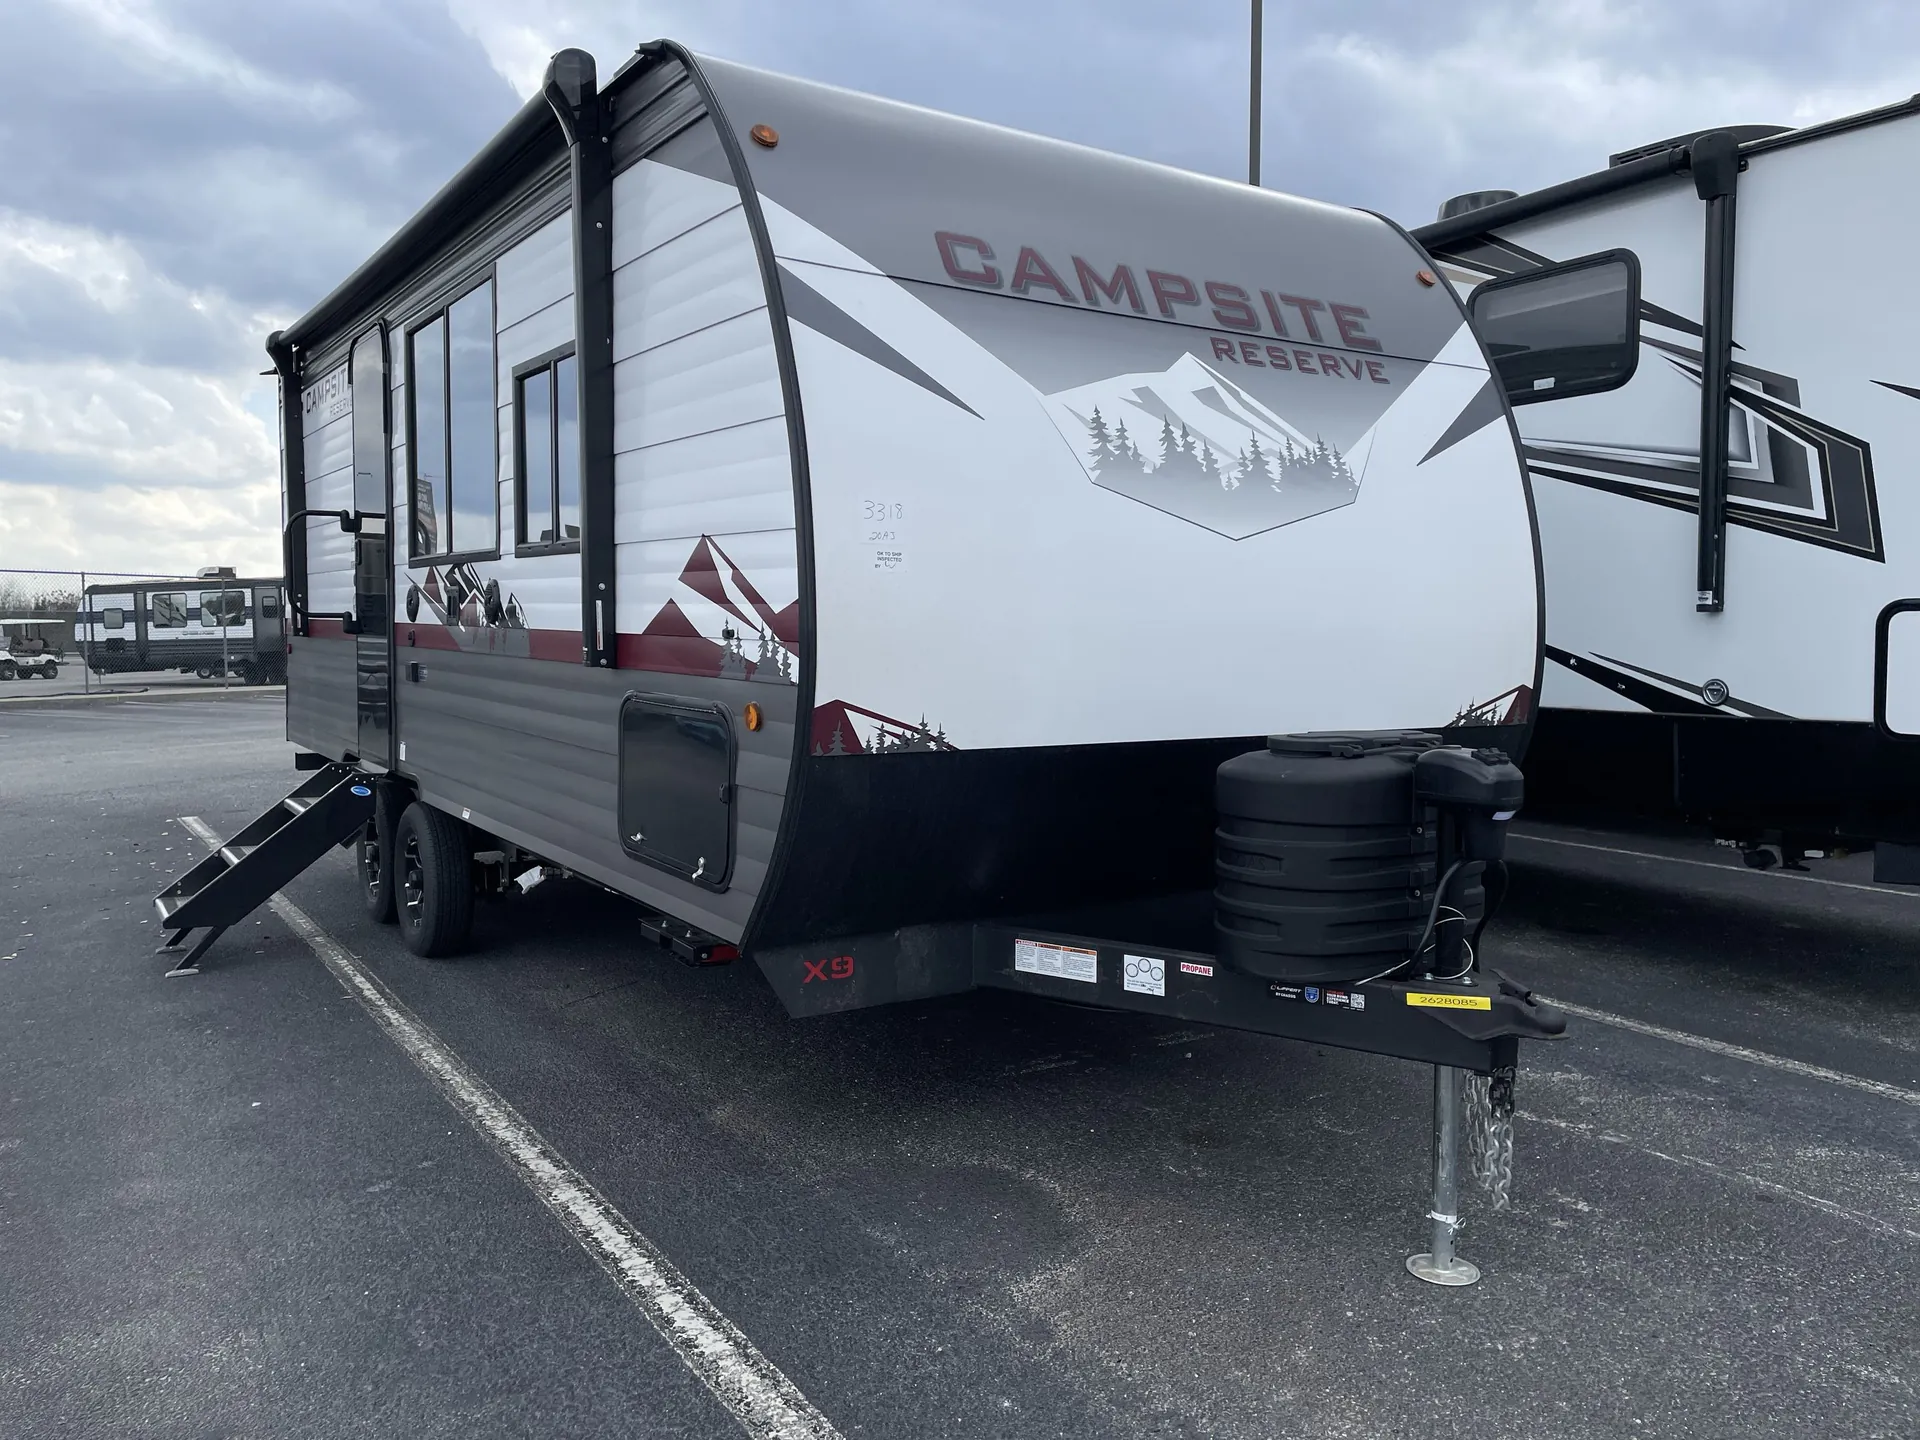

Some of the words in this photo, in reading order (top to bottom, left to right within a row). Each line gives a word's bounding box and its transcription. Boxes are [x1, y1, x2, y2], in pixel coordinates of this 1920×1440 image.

[934, 231, 1383, 353] CAMPSITE
[1209, 336, 1391, 385] RESERVE
[306, 368, 347, 414] CAMPSIT
[863, 500, 903, 521] 3318
[803, 955, 855, 984] X9
[1181, 963, 1212, 976] PROPANE
[1420, 996, 1478, 1007] 2628085
